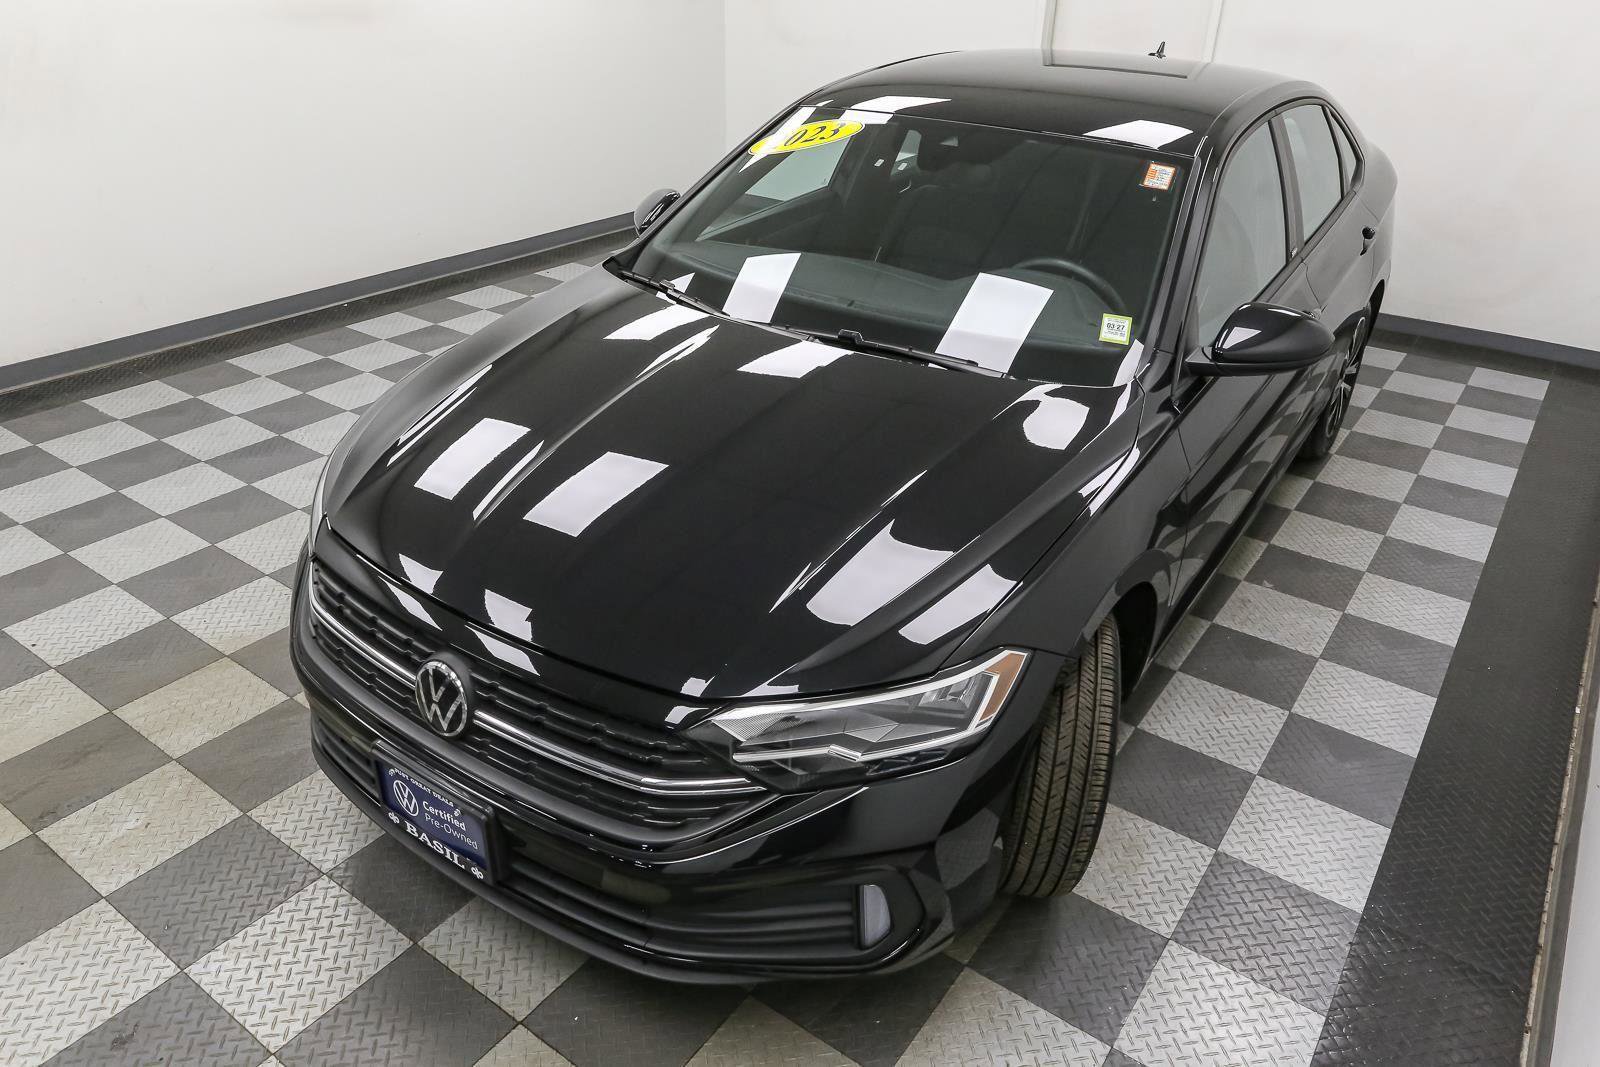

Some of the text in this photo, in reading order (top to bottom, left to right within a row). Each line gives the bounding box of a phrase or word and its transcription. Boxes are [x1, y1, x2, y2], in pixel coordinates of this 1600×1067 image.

[769, 122, 846, 149] 023
[422, 800, 467, 831] Certified
[425, 812, 479, 850] Pre-Owned
[404, 820, 466, 870] BASIL
